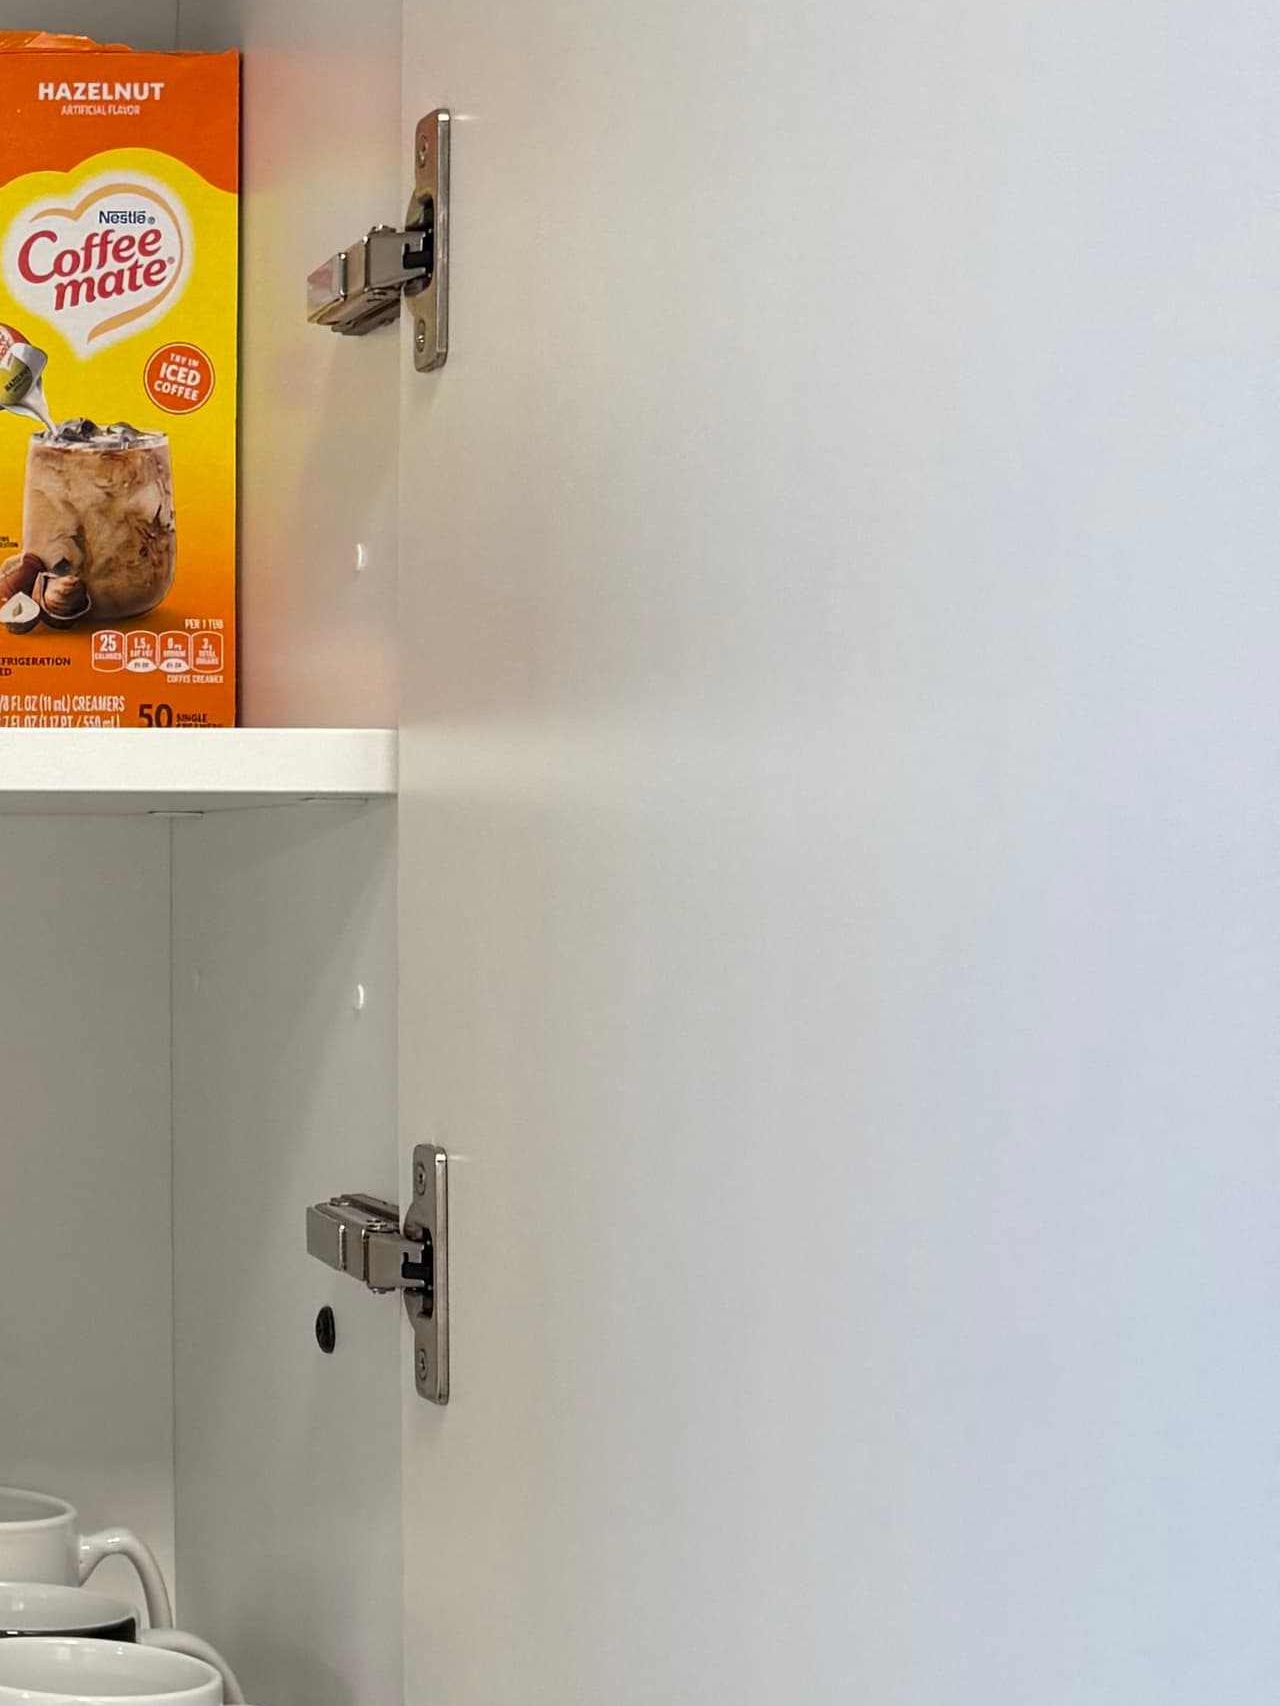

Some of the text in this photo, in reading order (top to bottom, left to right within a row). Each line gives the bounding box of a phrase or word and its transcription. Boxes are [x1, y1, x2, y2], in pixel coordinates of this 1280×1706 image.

[37, 81, 166, 102] HAZELNUT
[17, 228, 163, 285] Coffee
[53, 257, 167, 311] mate
[159, 363, 202, 387] ICED
[153, 380, 200, 402] COFFEE
[99, 634, 117, 653] 25
[138, 704, 174, 728] 50
